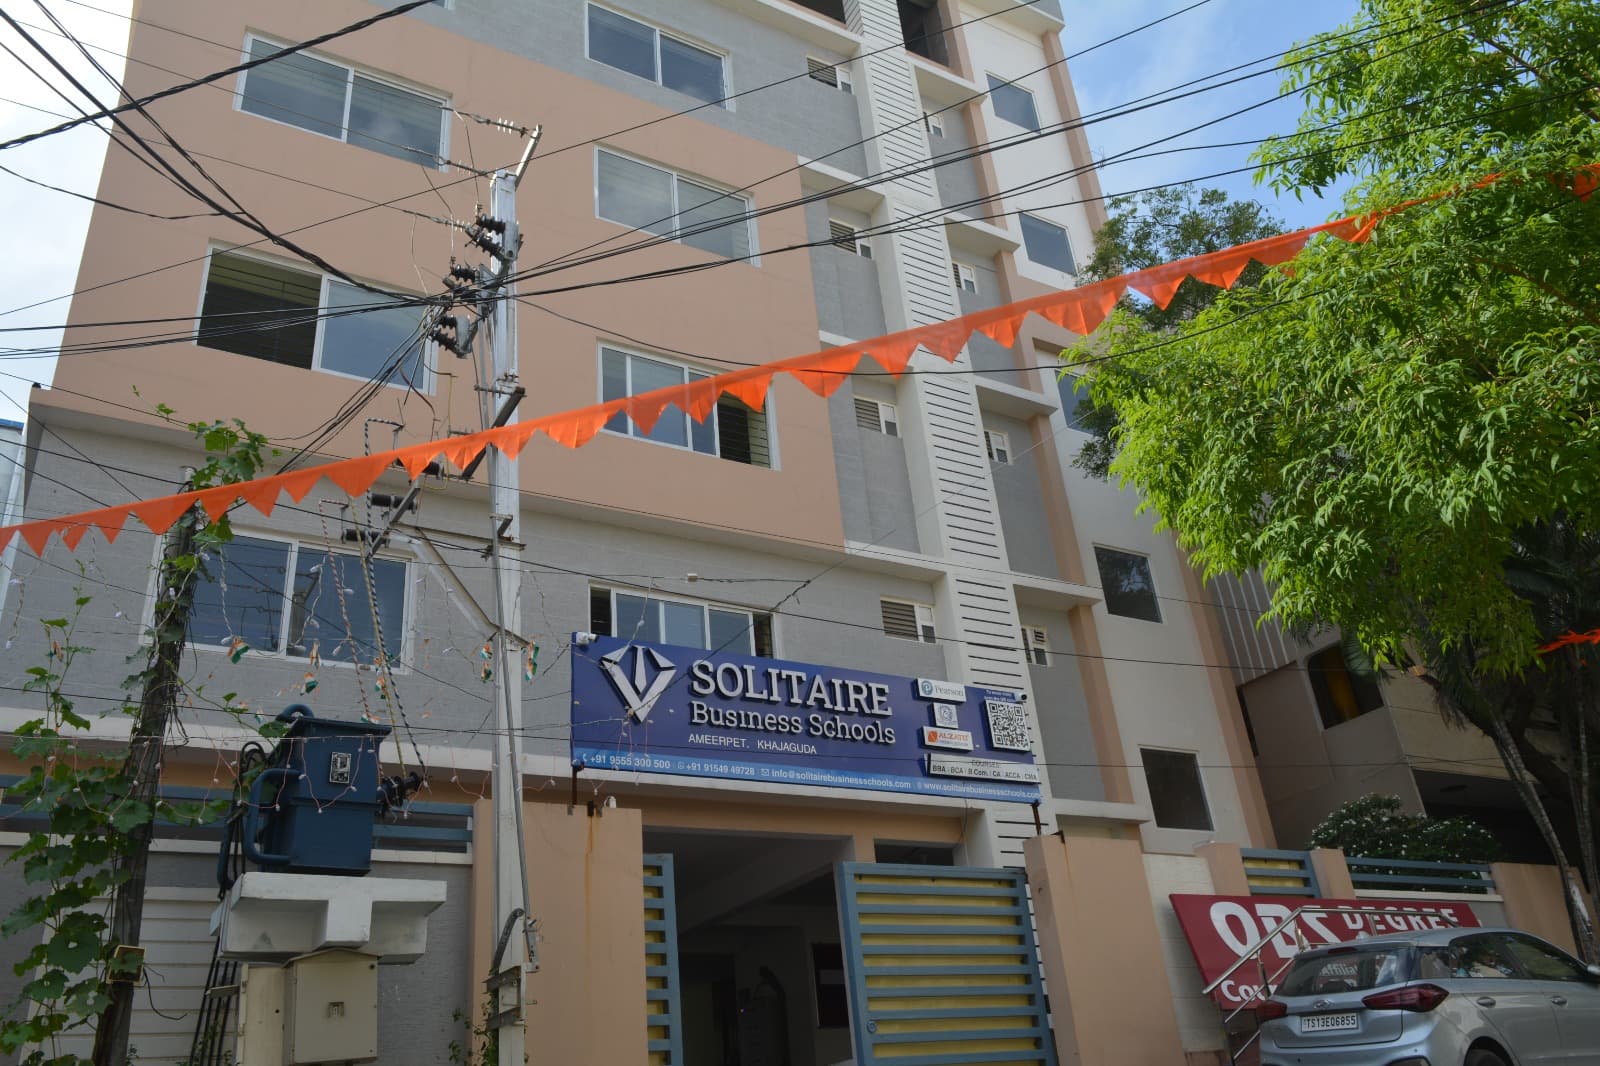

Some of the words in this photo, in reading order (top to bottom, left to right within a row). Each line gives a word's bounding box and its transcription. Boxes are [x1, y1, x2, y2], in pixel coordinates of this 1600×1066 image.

[691, 659, 893, 716] SOLITAIRE
[690, 700, 804, 734] Business
[809, 714, 896, 744] Schools
[590, 754, 606, 764] +91
[609, 755, 632, 766] 9555
[634, 757, 651, 768] 300
[653, 759, 671, 769] 500
[757, 739, 817, 755] KHAJAGUDA
